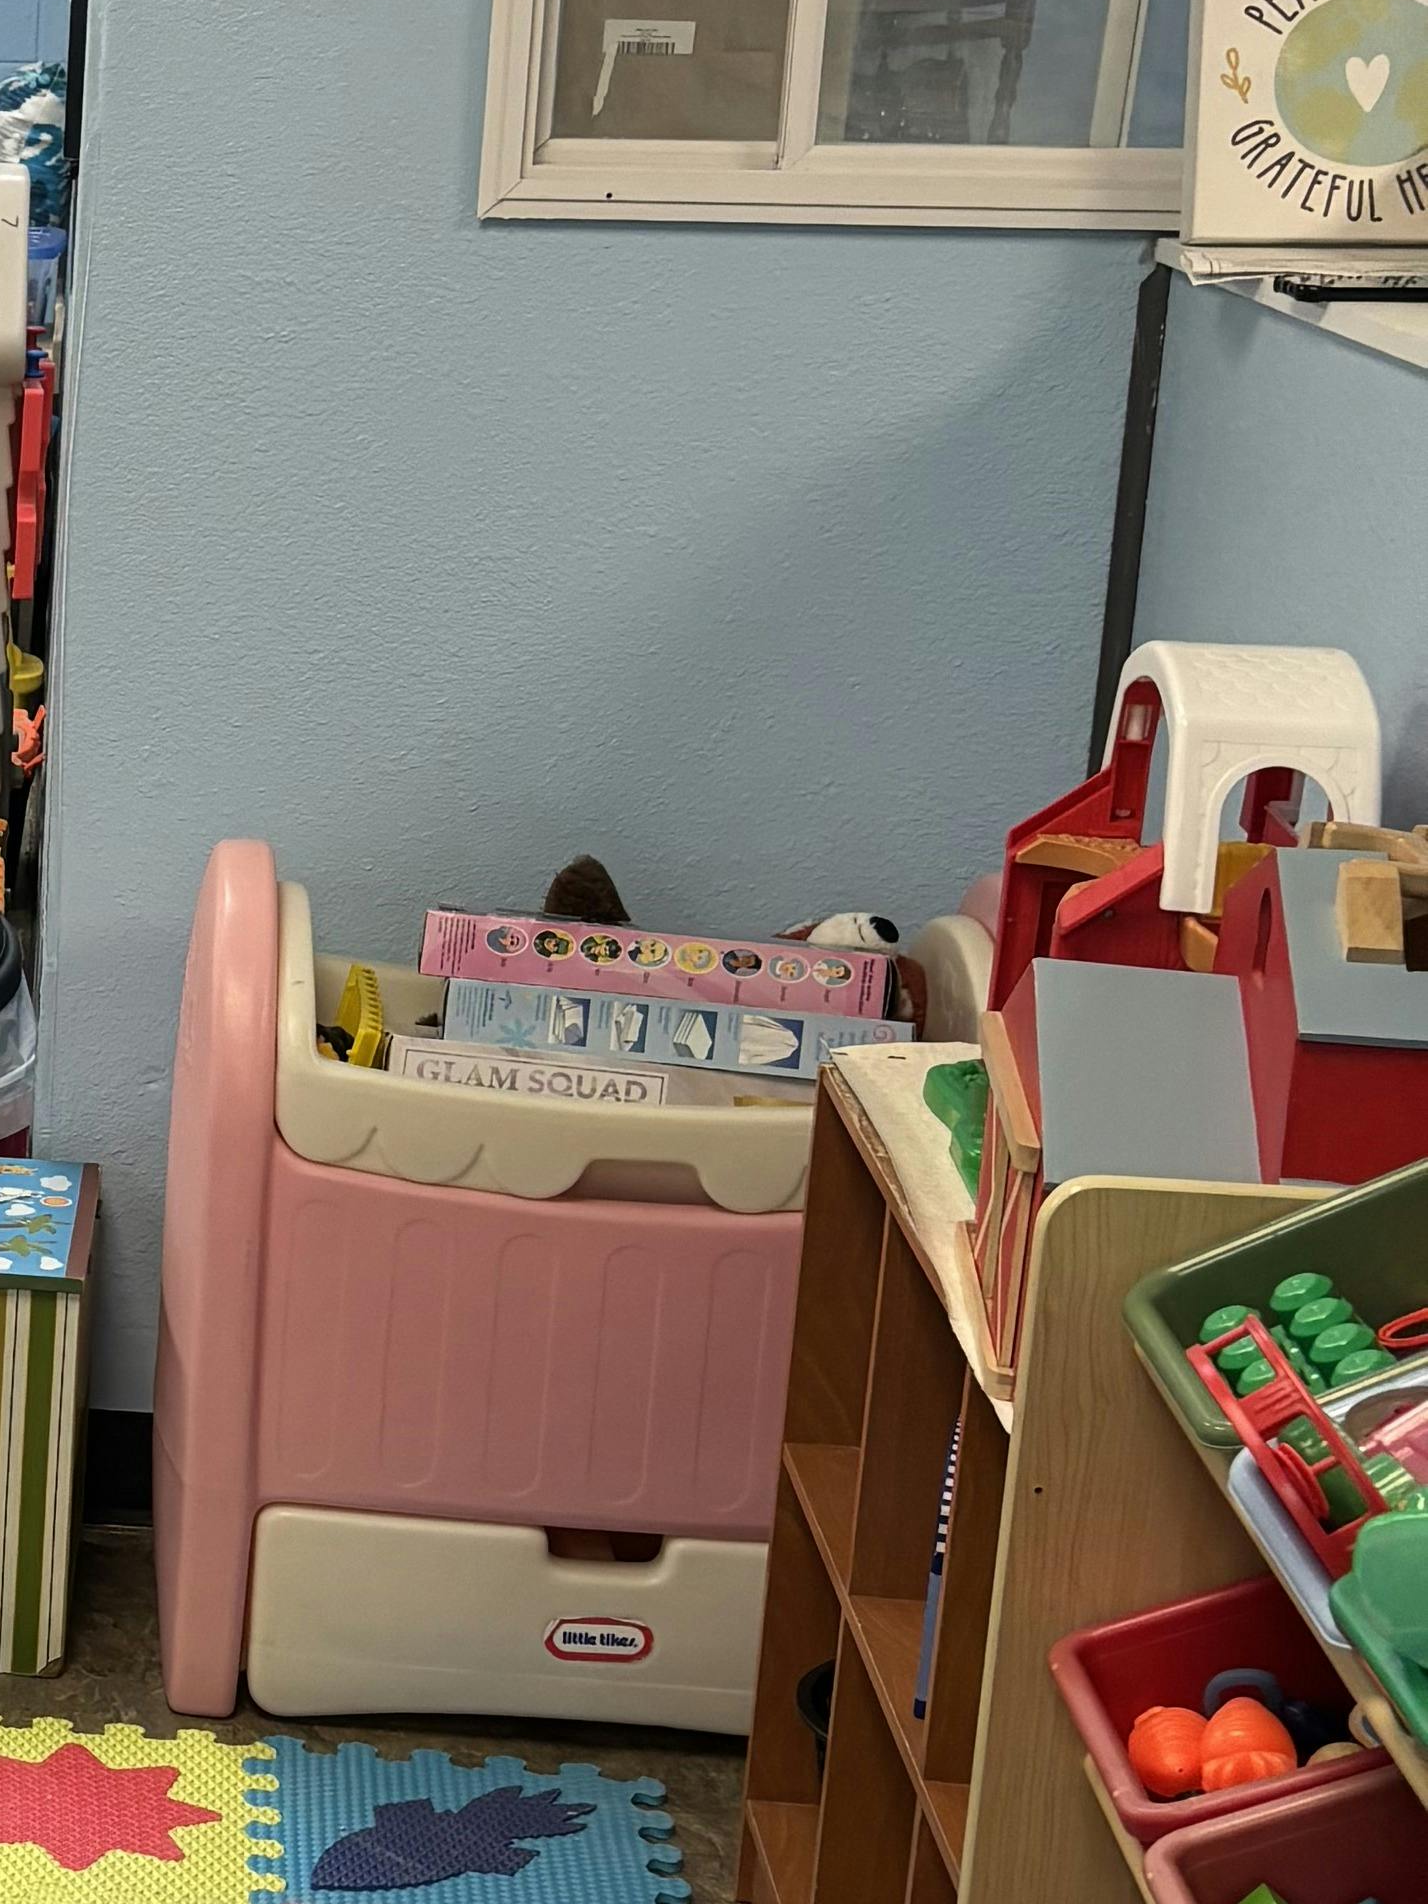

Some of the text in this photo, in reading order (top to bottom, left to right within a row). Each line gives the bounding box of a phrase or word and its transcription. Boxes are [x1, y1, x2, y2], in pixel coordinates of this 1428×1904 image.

[1231, 119, 1383, 222] GRATEFUL
[416, 1057, 648, 1104] GLAM SQUAD
[562, 1630, 597, 1646] little
